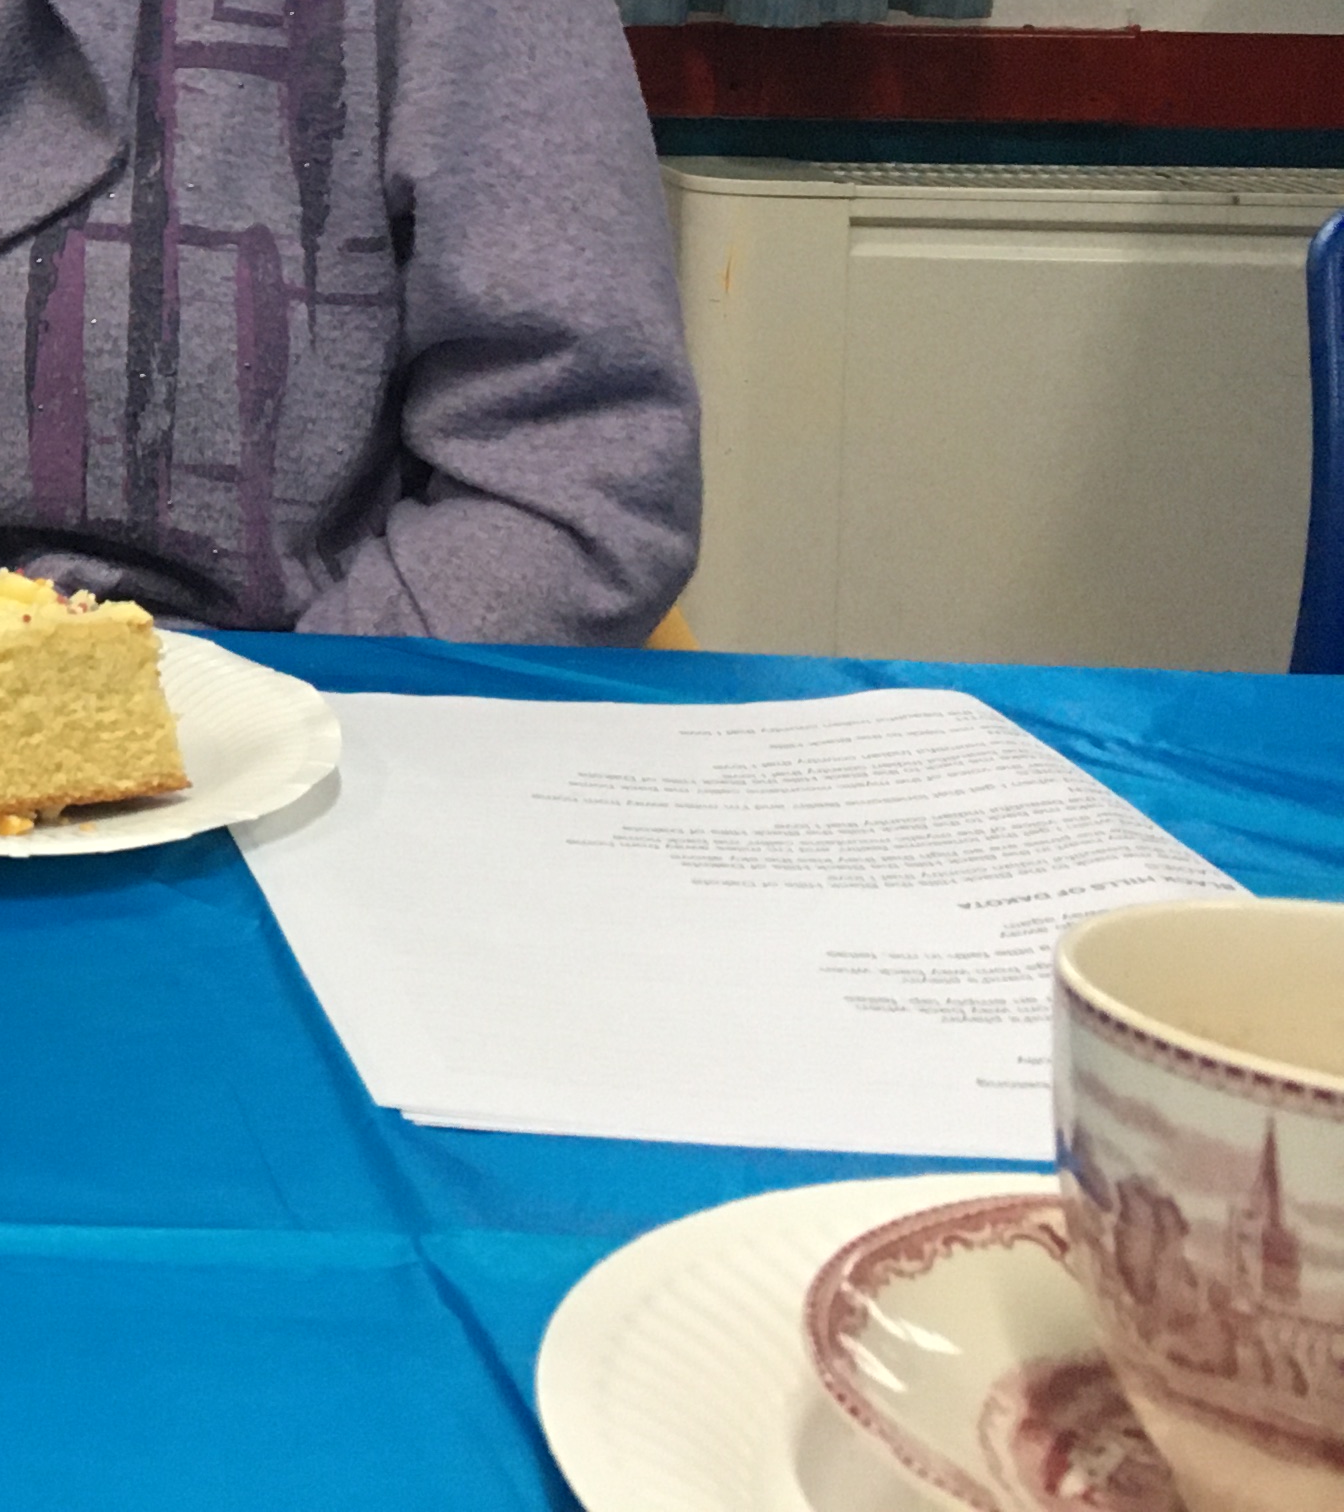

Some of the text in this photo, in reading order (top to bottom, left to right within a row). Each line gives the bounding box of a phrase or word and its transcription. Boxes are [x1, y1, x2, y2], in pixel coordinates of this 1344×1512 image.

[957, 876, 1236, 909] BLACK HILLS OF DAKOTA
